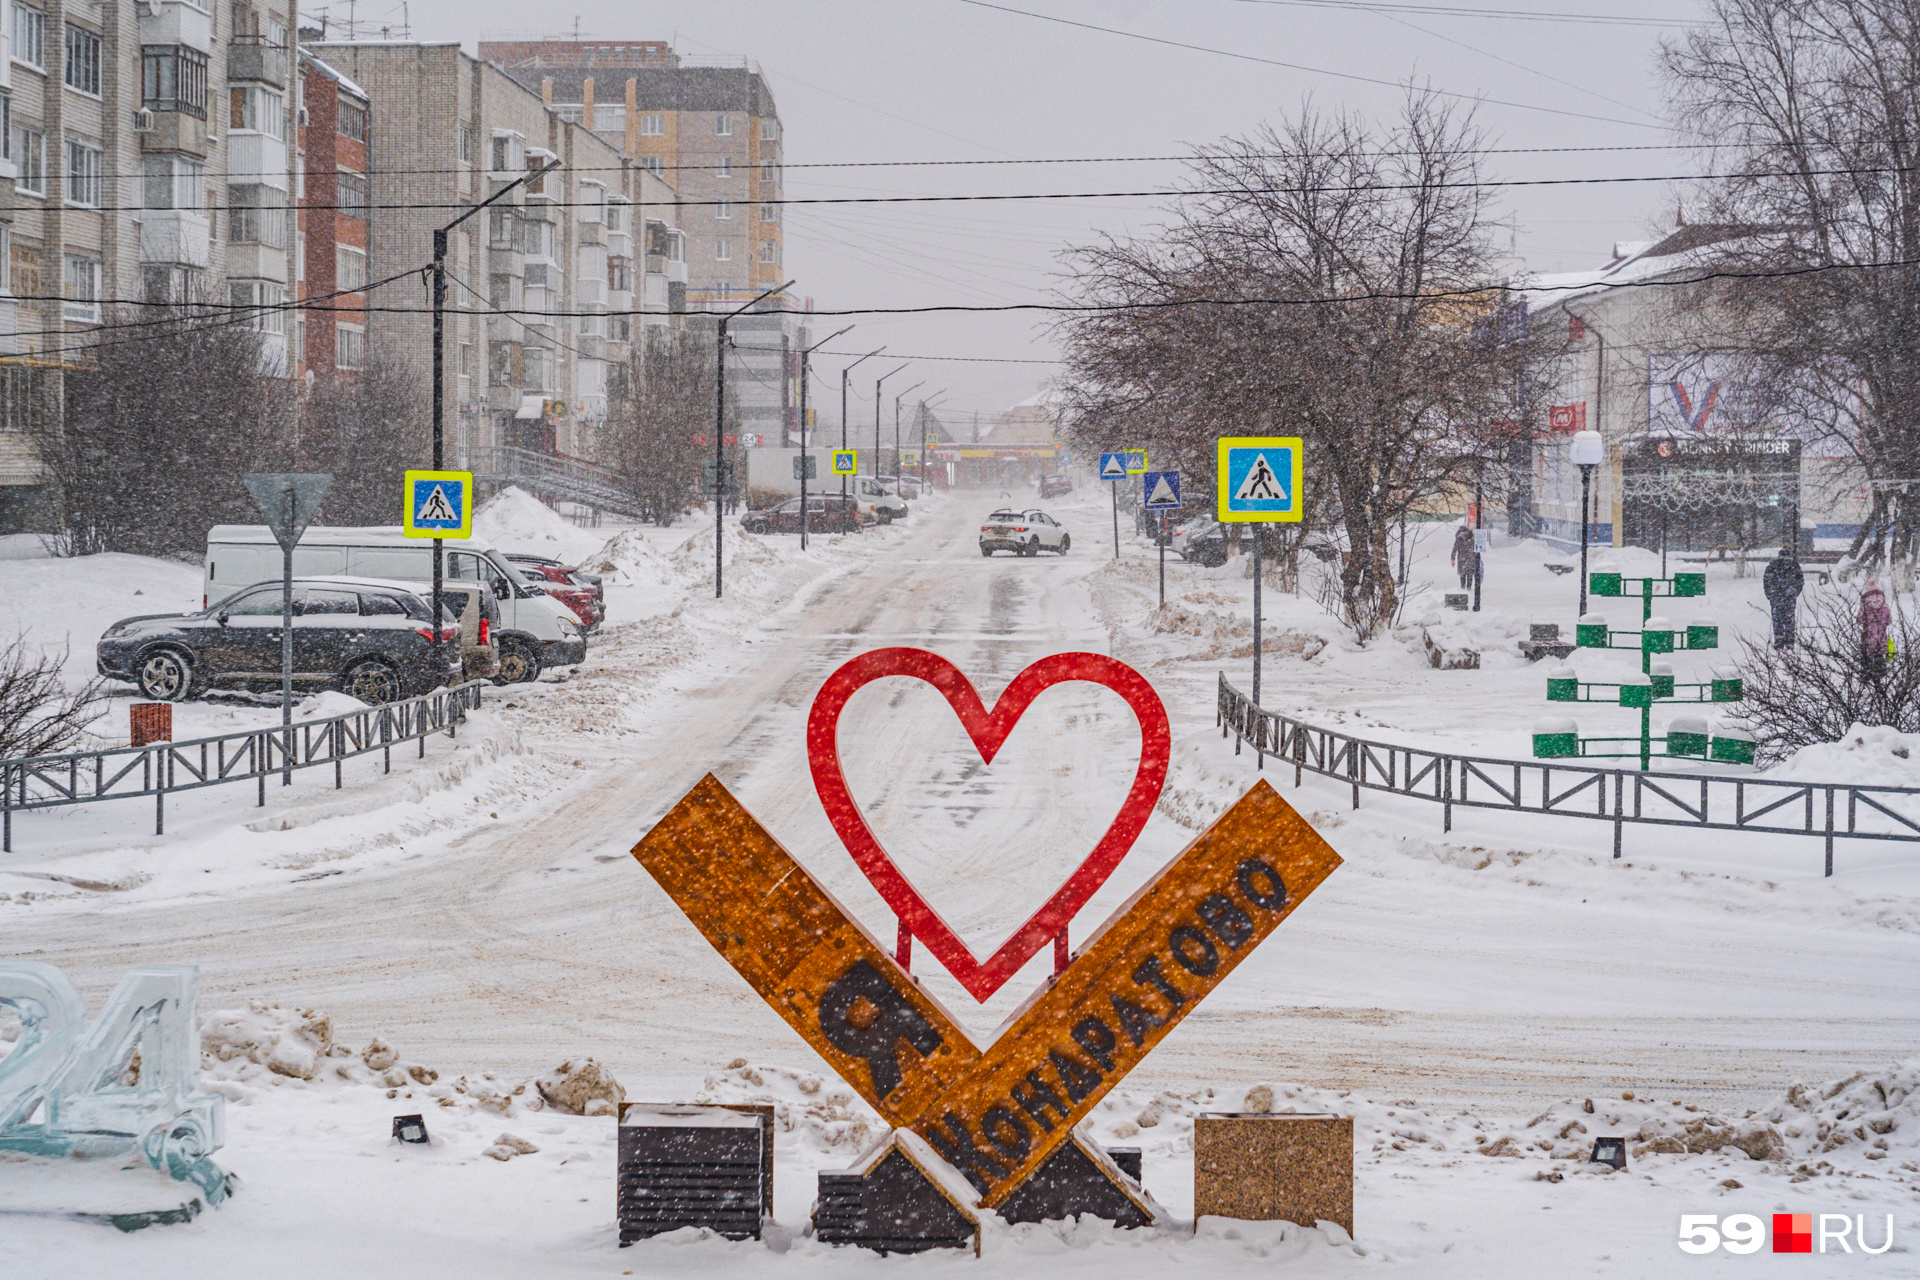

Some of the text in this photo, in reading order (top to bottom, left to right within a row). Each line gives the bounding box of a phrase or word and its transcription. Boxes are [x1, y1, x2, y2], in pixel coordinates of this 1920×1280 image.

[1734, 440, 1790, 454] RINDER
[818, 957, 944, 1100] Я
[925, 859, 1287, 1195] КОНДРАТОВО
